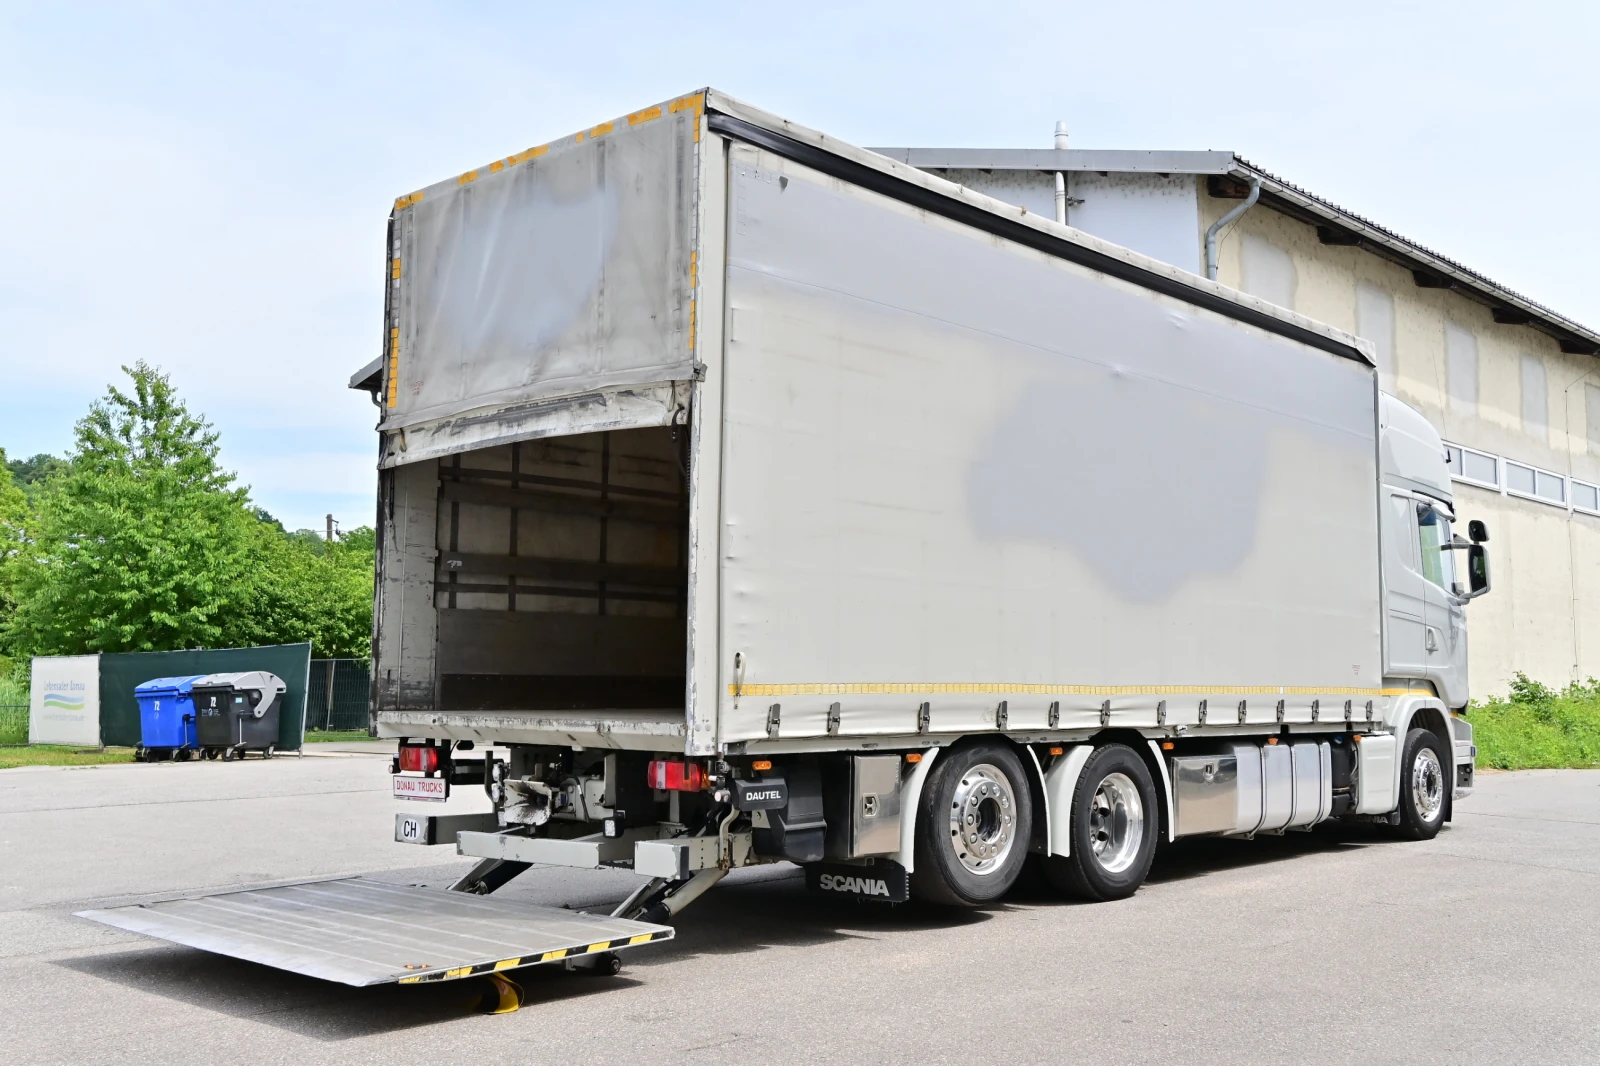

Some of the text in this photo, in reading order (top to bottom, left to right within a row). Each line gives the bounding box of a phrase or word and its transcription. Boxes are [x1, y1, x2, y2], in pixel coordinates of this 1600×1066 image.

[154, 700, 160, 711] 72
[210, 696, 217, 707] 72
[396, 780, 443, 793] DONAU TRUCKS
[746, 790, 782, 801] DAUTEL
[403, 820, 417, 838] CH
[819, 873, 890, 896] SCANIA
